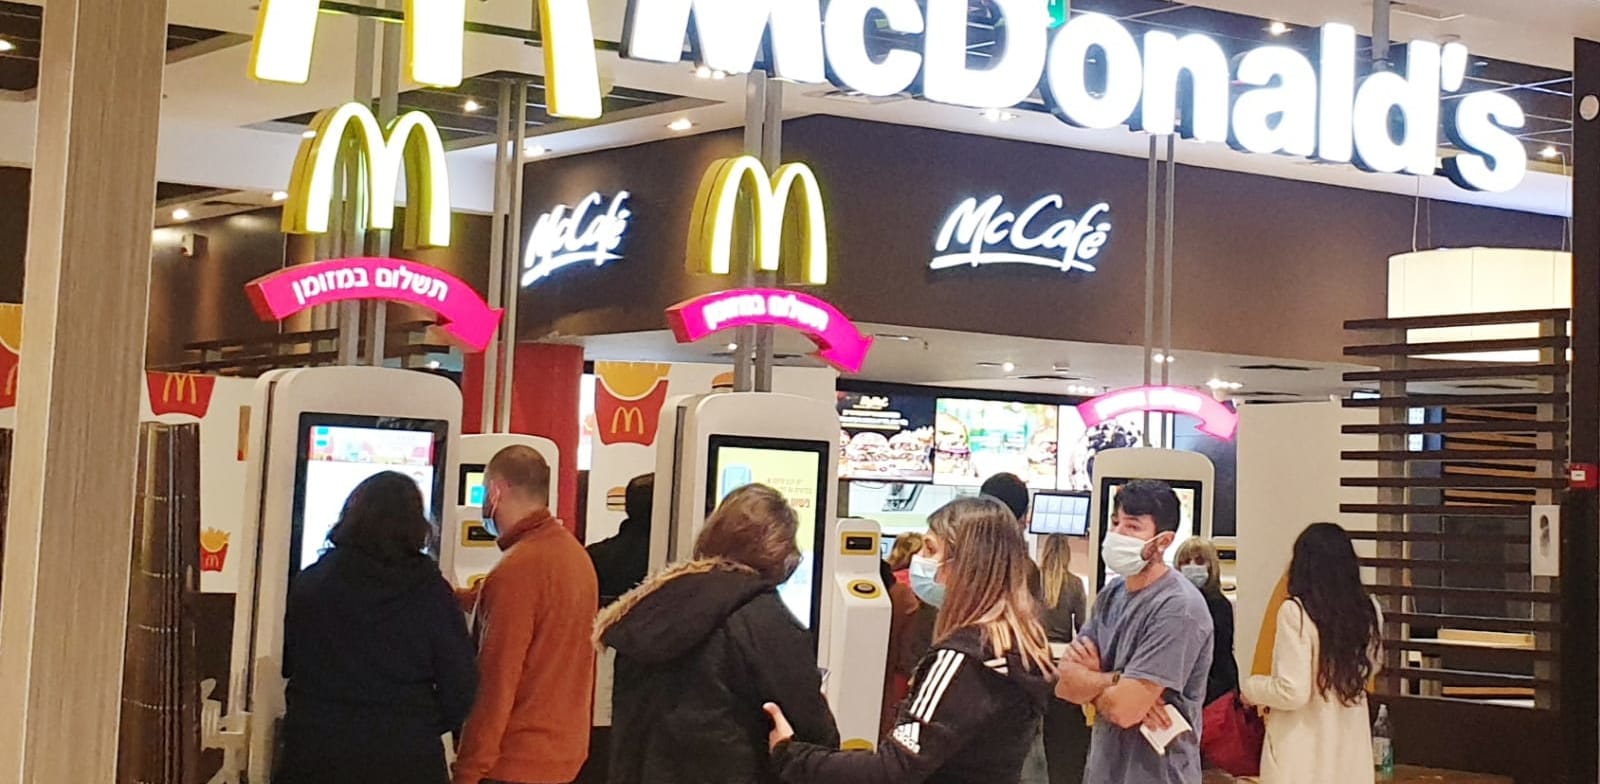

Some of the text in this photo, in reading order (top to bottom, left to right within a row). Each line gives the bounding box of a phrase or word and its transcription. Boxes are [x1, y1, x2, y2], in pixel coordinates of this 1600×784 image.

[934, 194, 1112, 272] McCafé
[291, 264, 449, 305] תשלום במזומן
